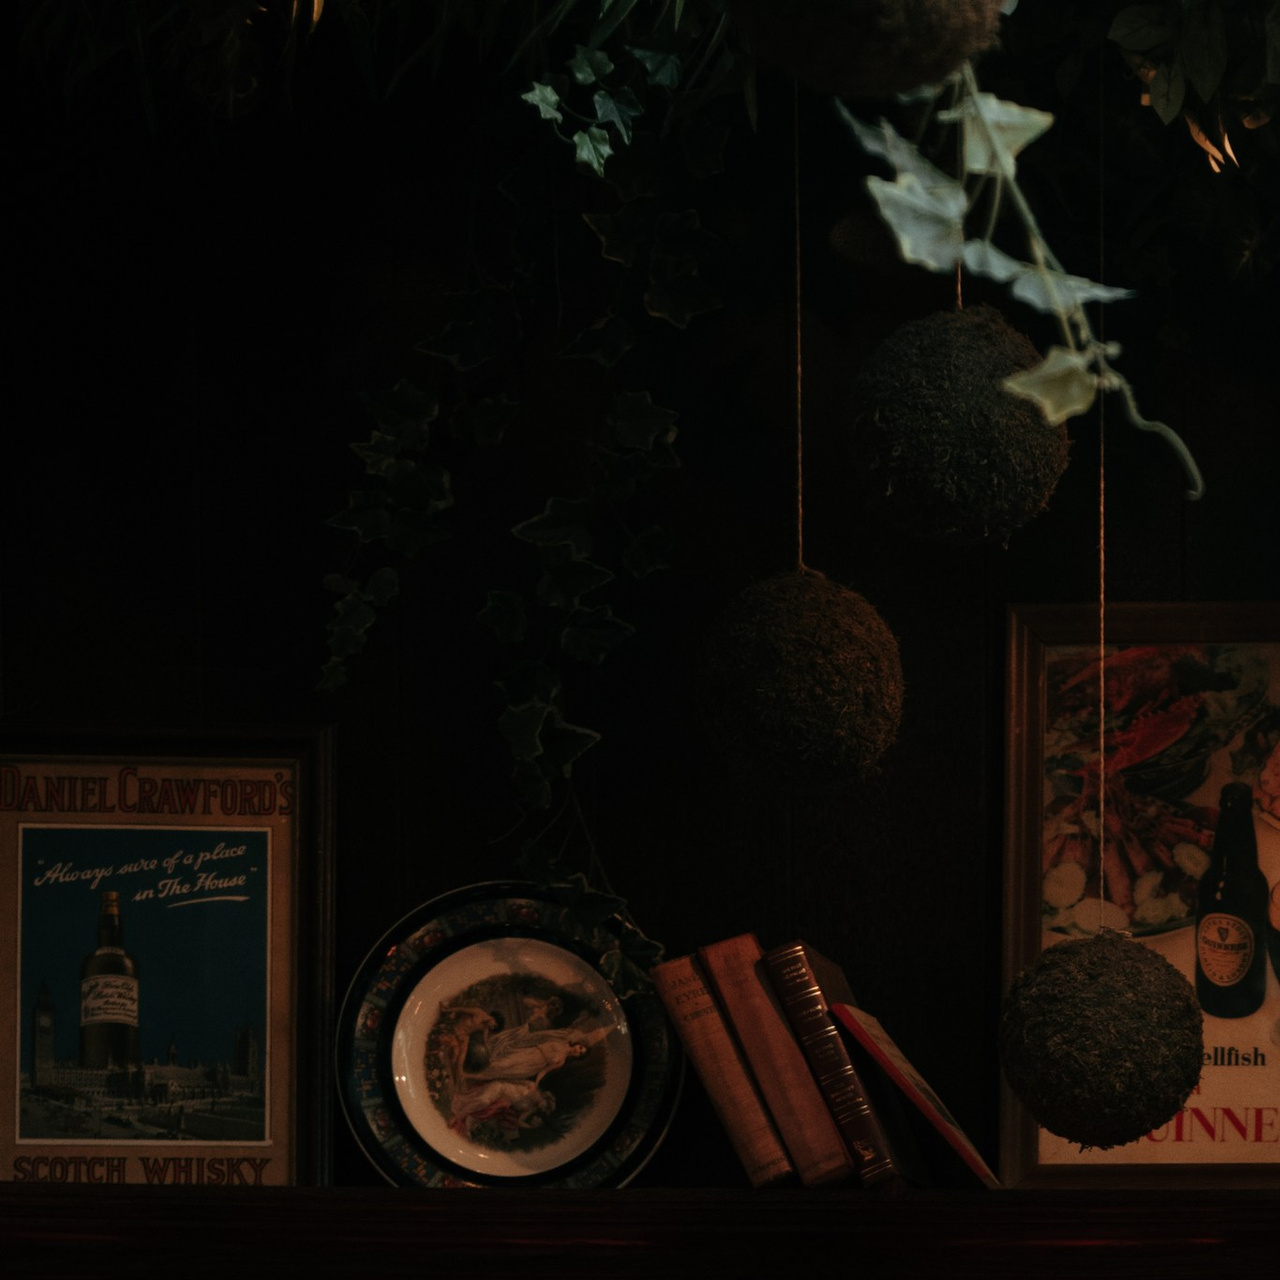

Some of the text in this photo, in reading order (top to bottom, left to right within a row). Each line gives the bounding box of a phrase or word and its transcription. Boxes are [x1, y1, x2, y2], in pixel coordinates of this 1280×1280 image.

[0, 764, 295, 817] DANIEL CRAWFORD'S
[116, 858, 158, 876] sure
[161, 849, 182, 875] of
[183, 853, 194, 866] a
[195, 841, 248, 871] place
[131, 883, 155, 902] in
[157, 875, 191, 899] The
[1201, 1046, 1267, 1067] ellfish
[13, 1156, 272, 1187] SCOTCH WHISKY
